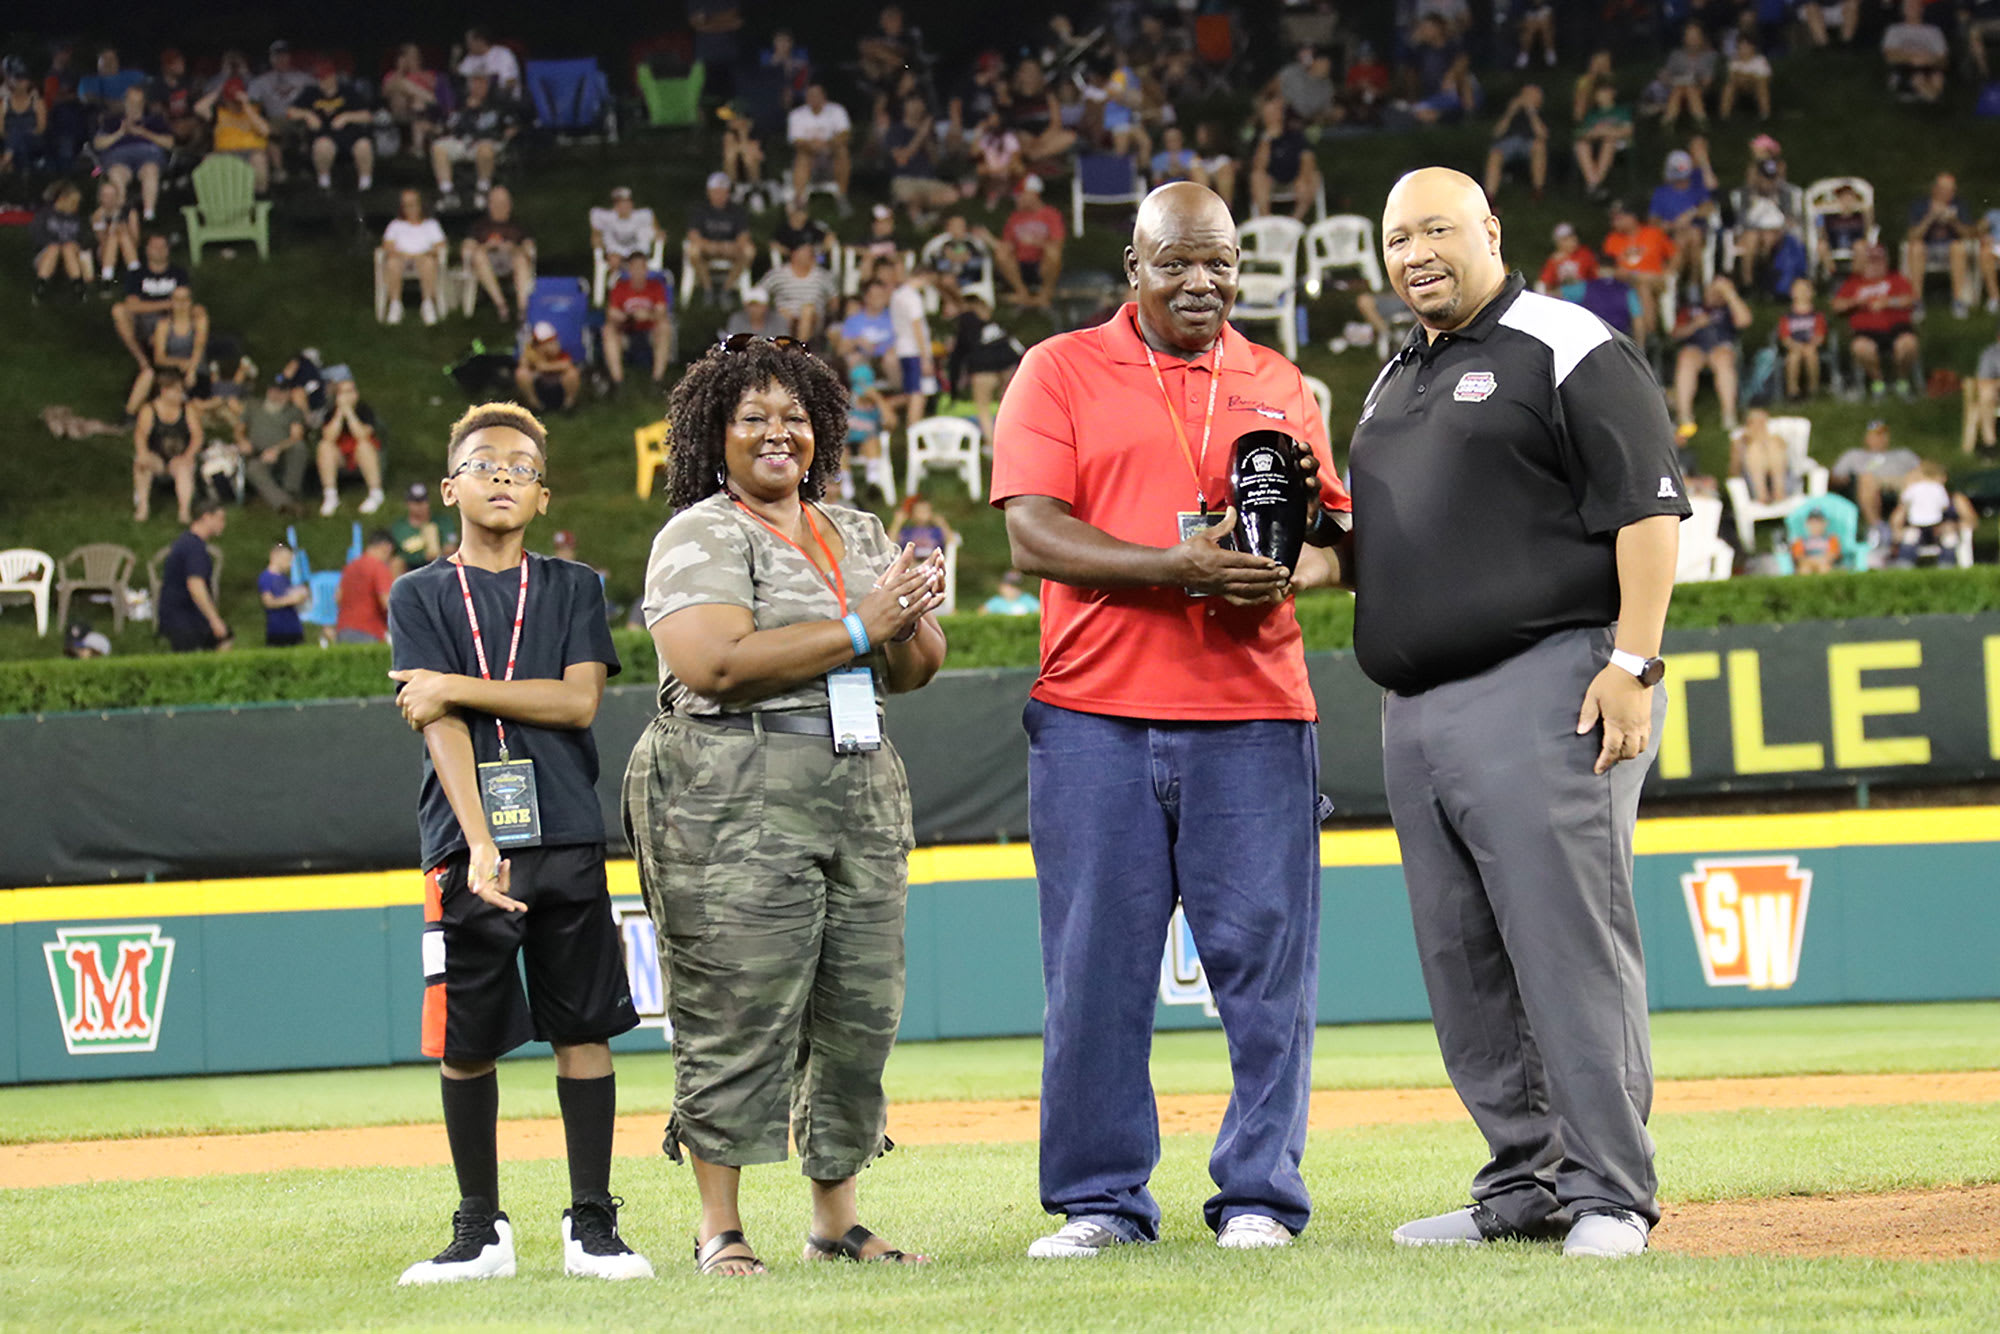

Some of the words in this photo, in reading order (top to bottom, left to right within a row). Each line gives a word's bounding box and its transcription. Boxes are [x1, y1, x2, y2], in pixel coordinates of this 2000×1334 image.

[491, 808, 531, 826] ONE
[1702, 870, 1793, 989] SW
[68, 943, 151, 1038] M
